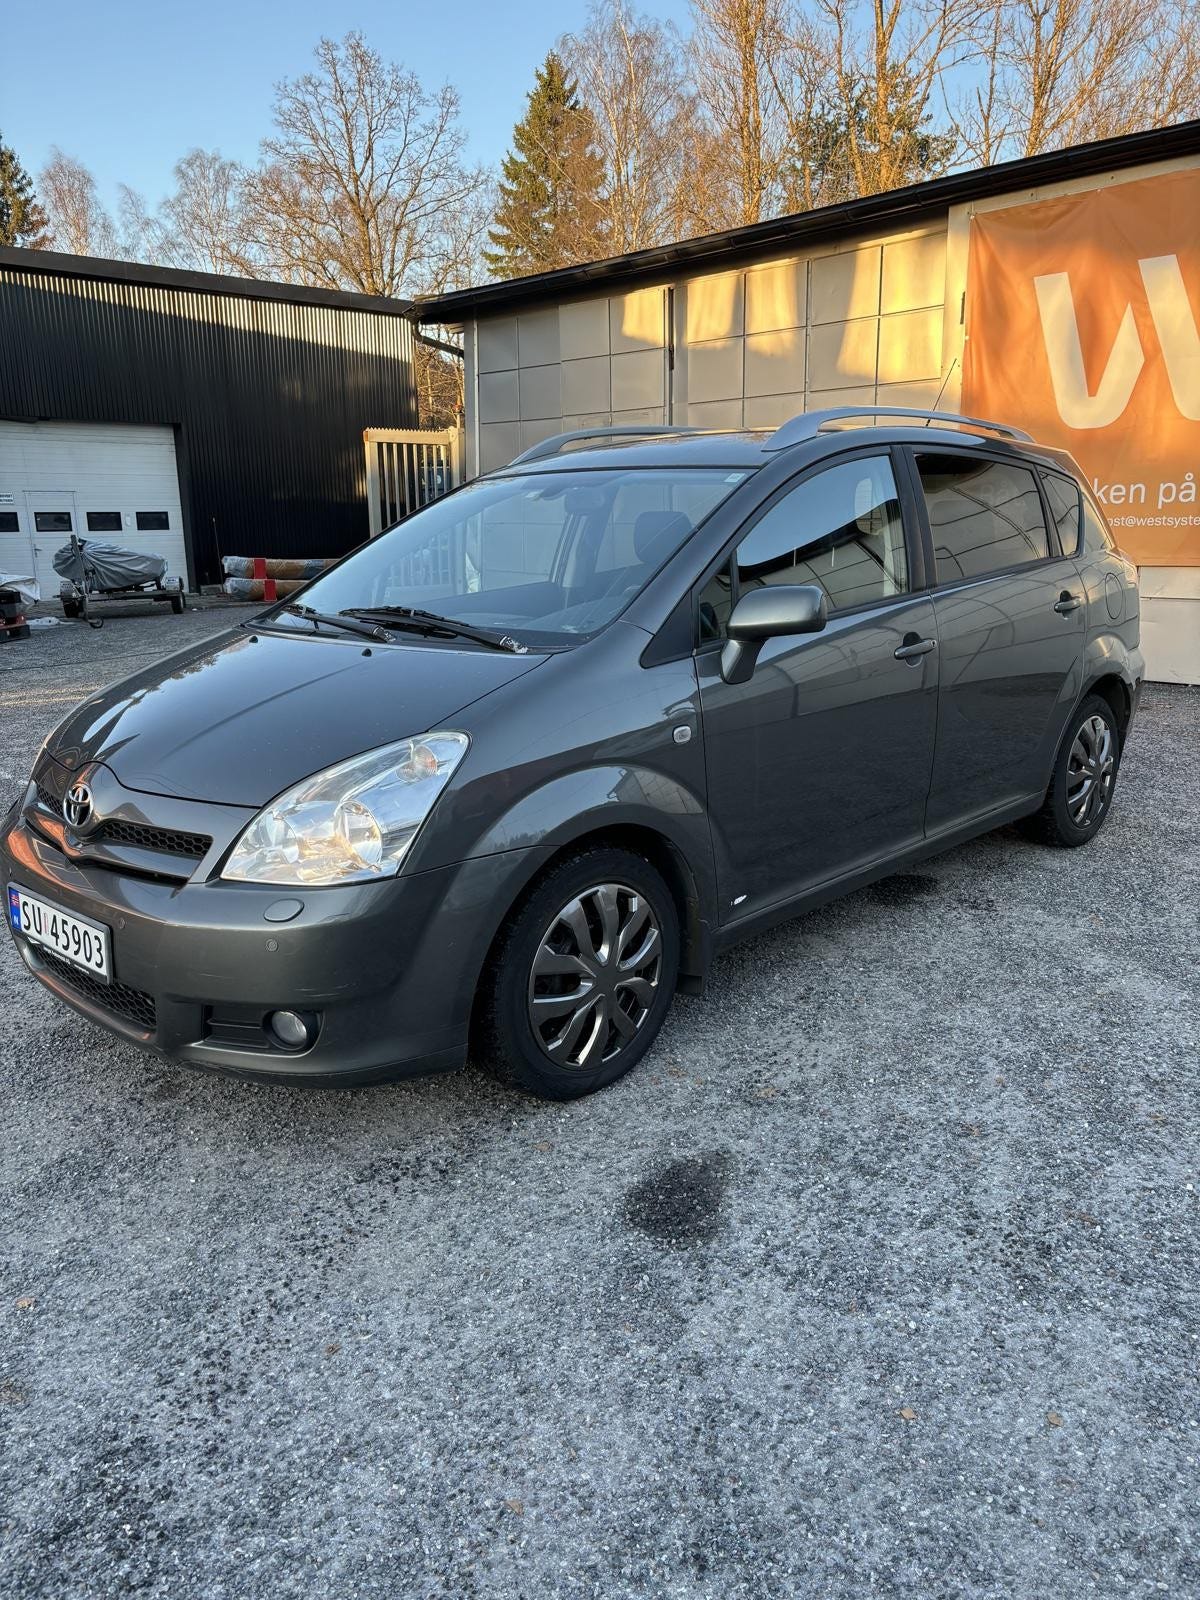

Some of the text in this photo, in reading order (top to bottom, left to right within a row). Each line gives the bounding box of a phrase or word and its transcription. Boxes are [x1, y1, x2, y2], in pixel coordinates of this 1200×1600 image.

[1158, 472, 1196, 509] på
[22, 901, 42, 935] SU
[50, 914, 104, 968] 45903
